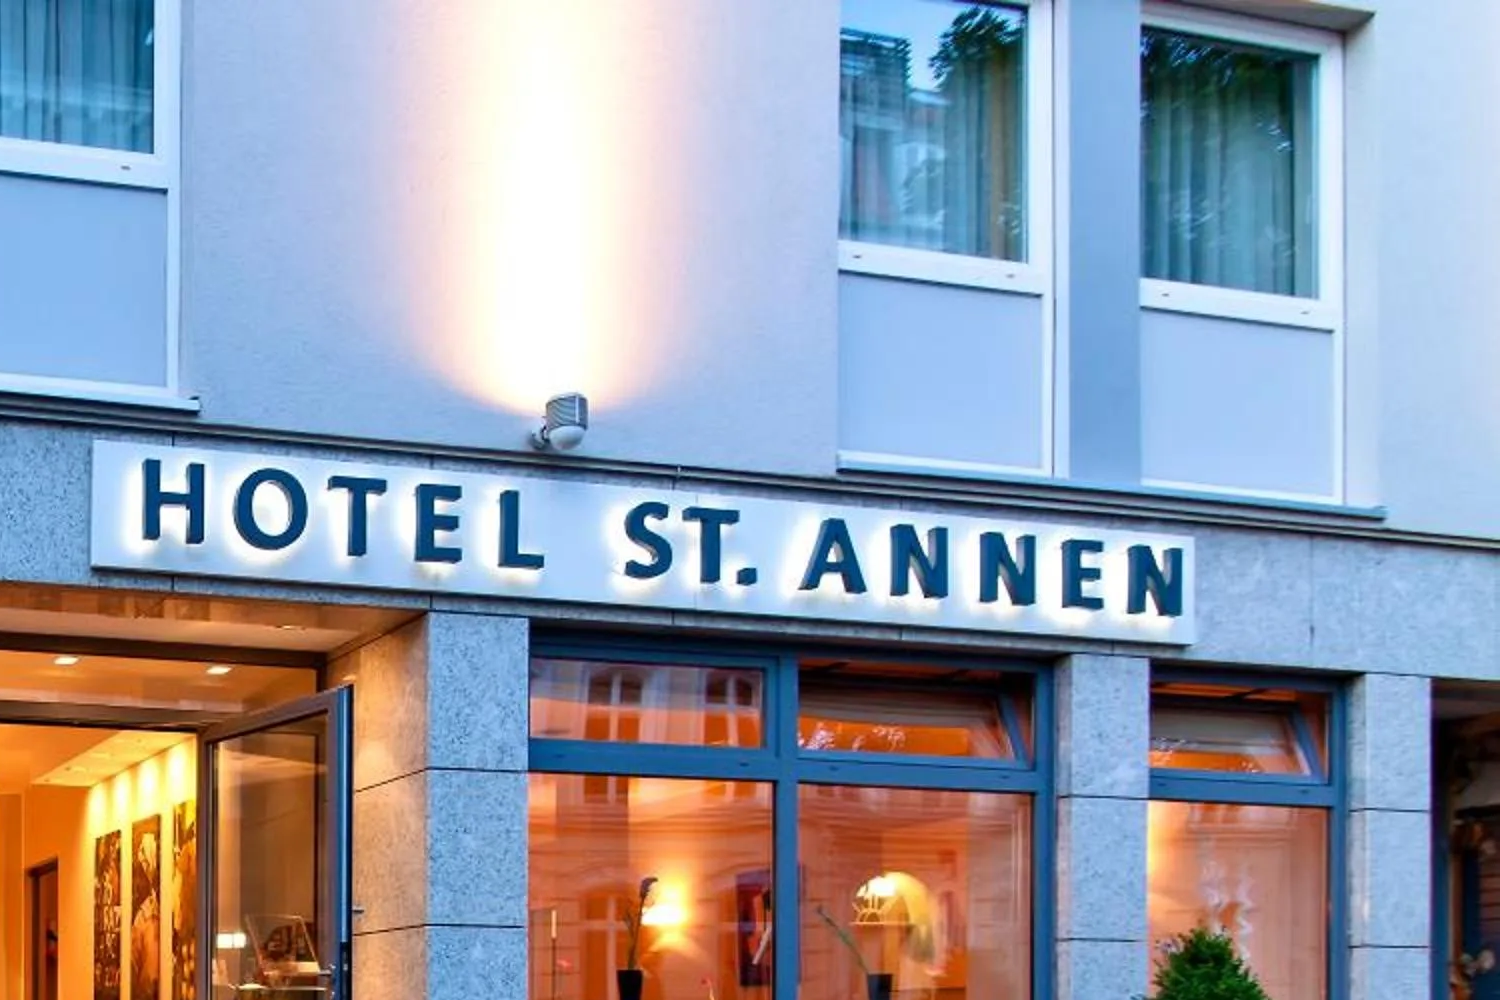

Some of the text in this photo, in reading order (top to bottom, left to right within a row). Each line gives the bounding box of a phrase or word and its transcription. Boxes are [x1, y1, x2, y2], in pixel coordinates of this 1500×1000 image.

[141, 458, 1184, 617] HOTEL ST. ANNEN
